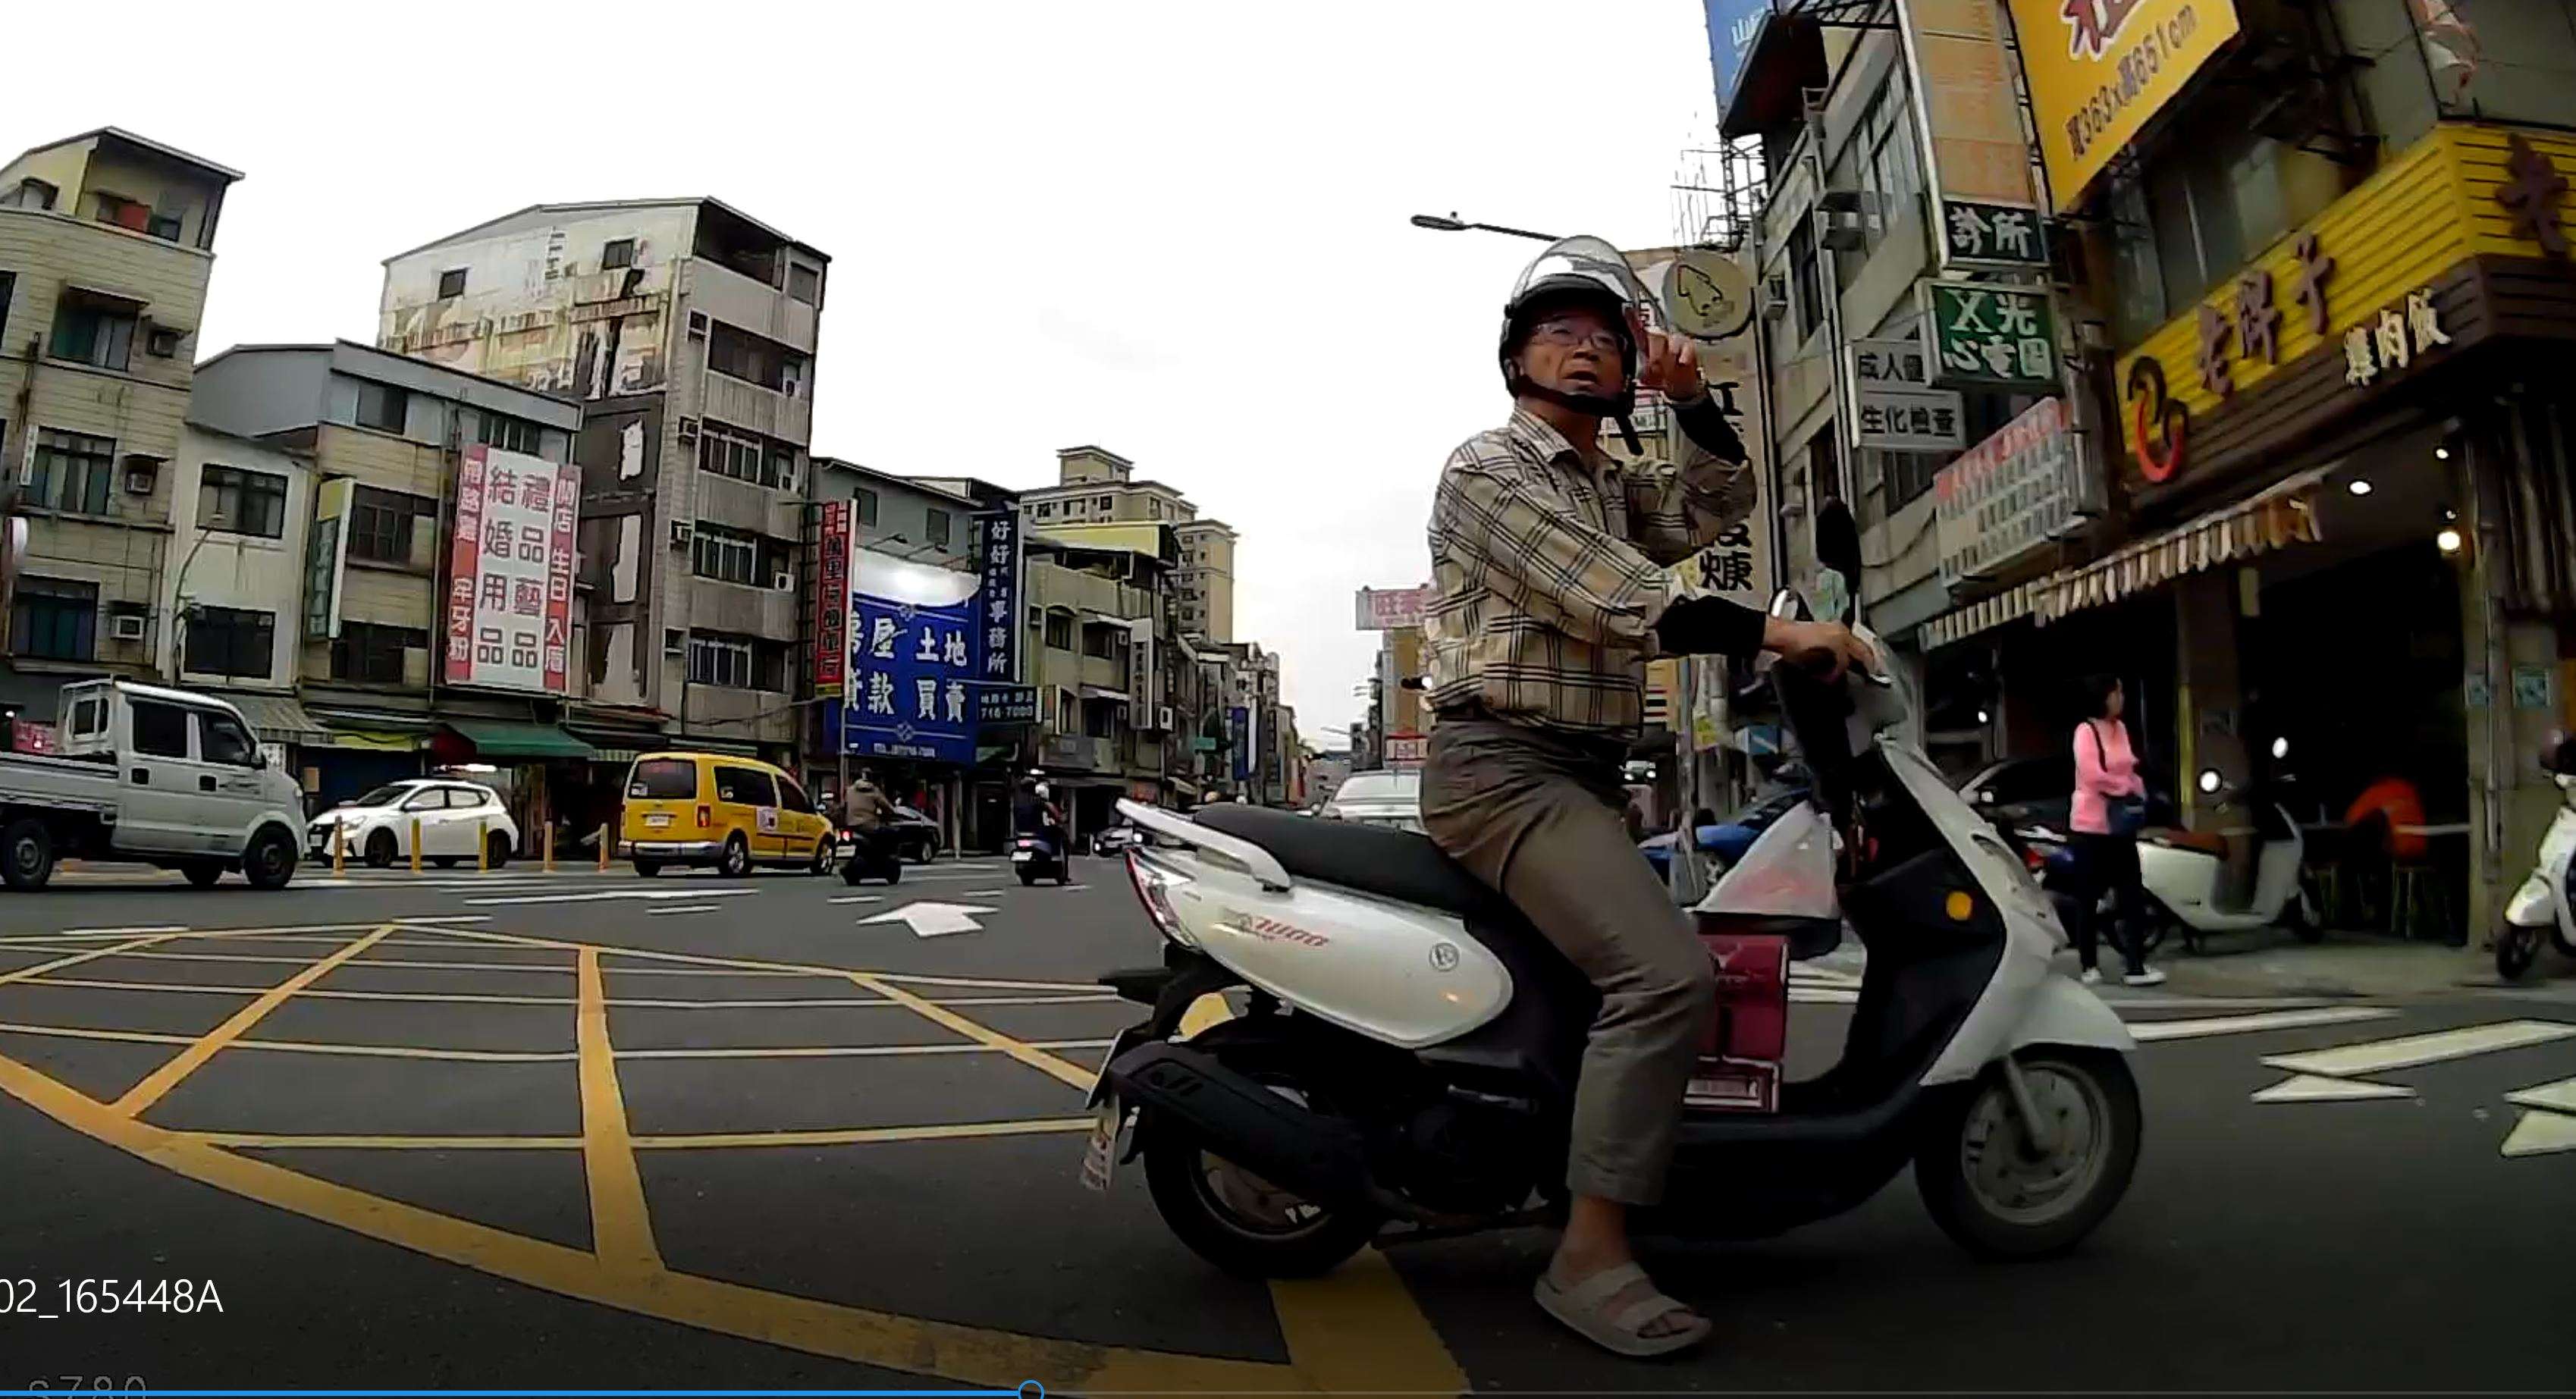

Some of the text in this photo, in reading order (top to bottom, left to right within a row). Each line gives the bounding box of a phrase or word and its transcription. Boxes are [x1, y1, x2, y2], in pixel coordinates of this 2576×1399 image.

[1949, 206, 2032, 258] 診所
[1944, 288, 2038, 336] X光
[477, 464, 519, 665] 結婚用品
[915, 626, 968, 667] 土地
[916, 679, 966, 723] 買賣
